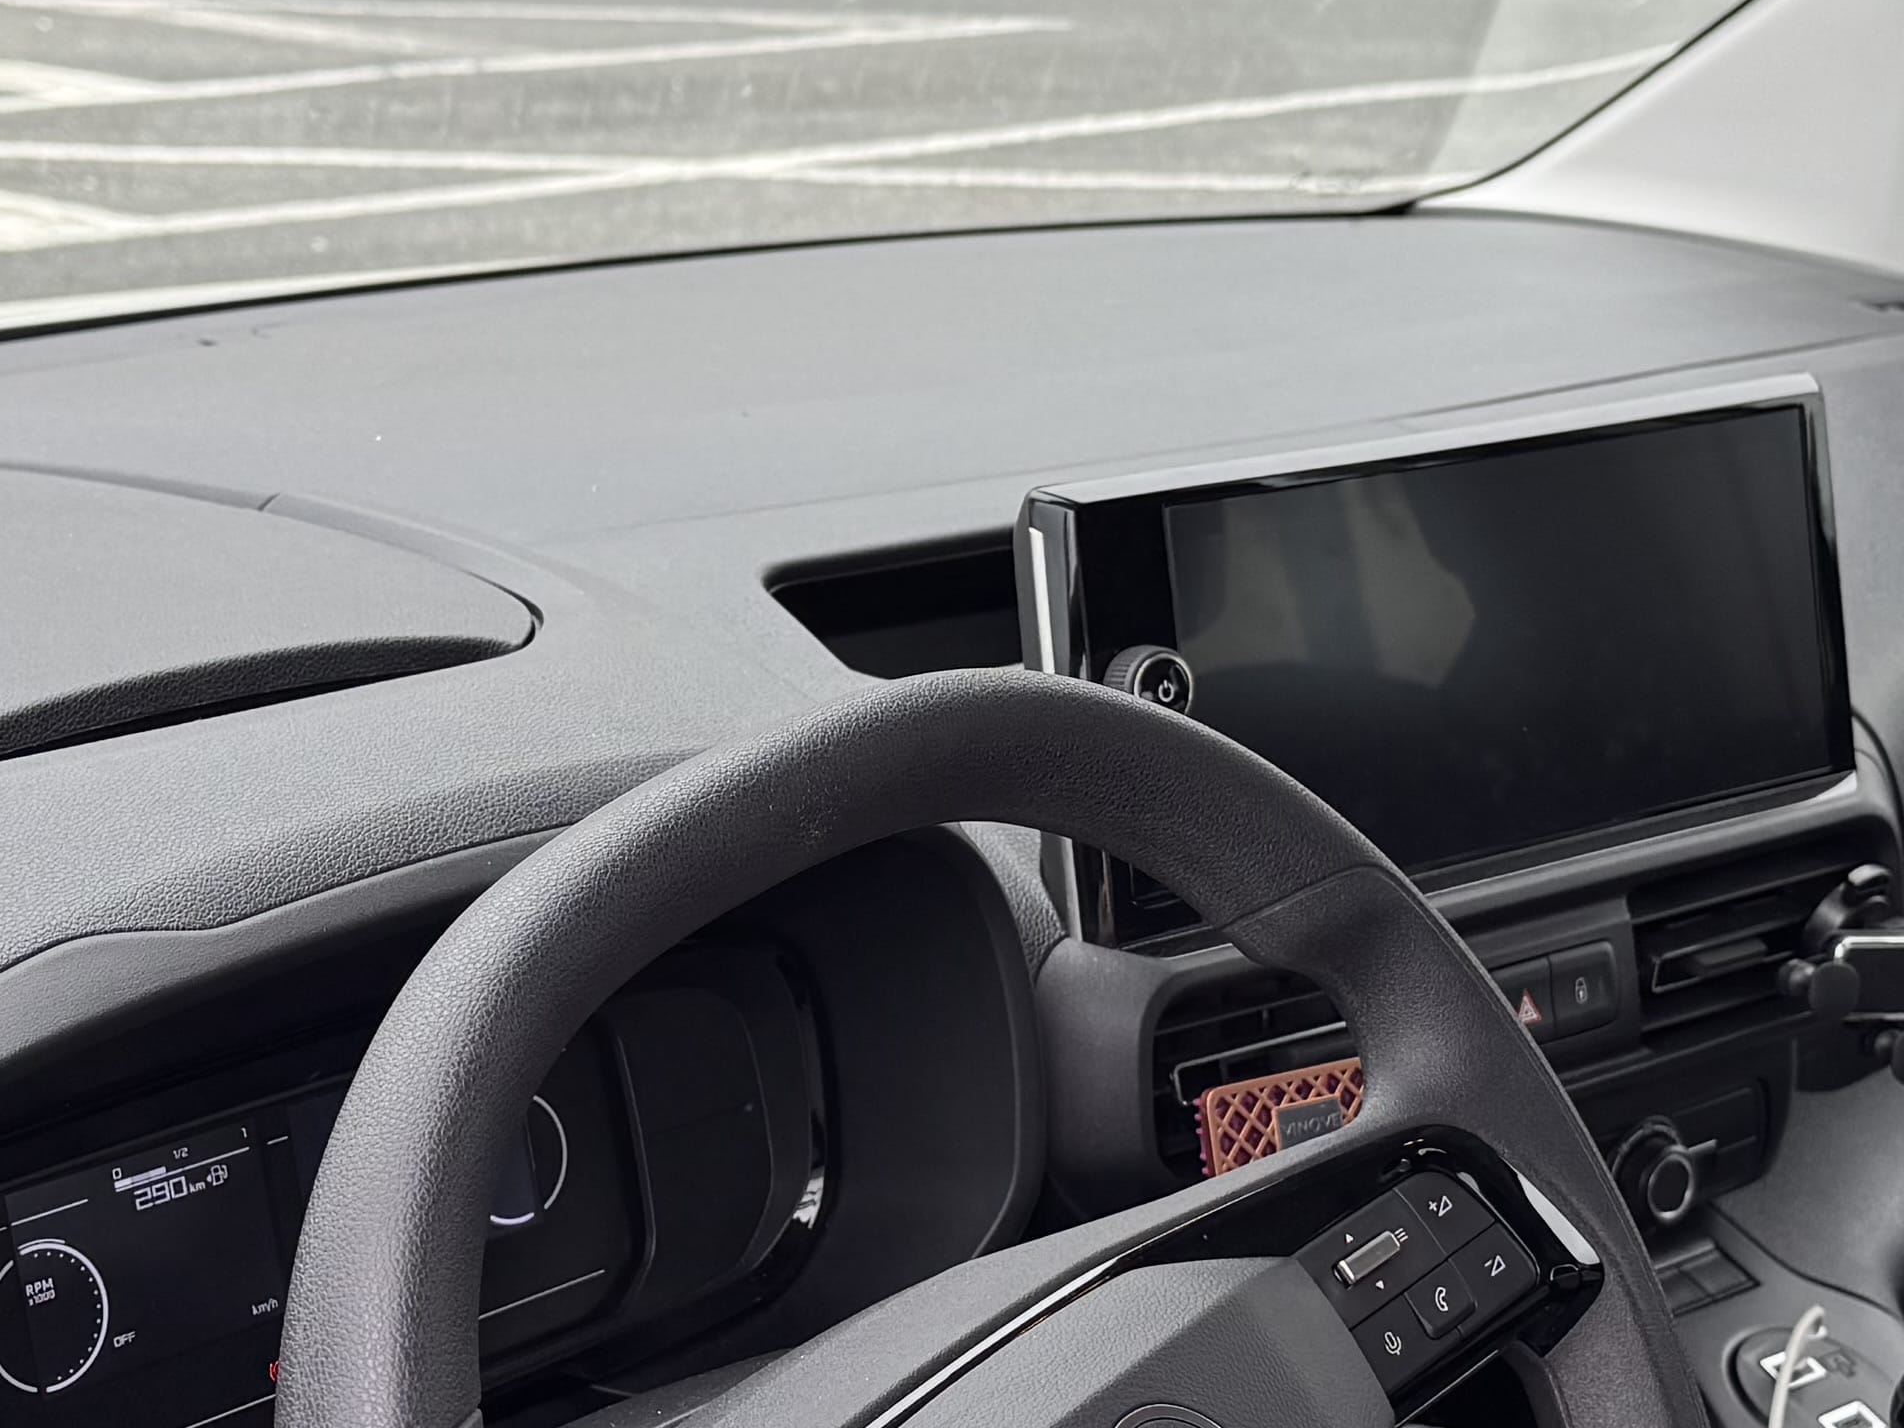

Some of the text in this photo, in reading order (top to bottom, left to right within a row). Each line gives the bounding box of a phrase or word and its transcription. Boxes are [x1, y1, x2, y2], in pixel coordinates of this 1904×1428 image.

[133, 1175, 206, 1211] 290 km
[25, 1277, 54, 1297] RPM
[113, 1331, 136, 1348] OFF
